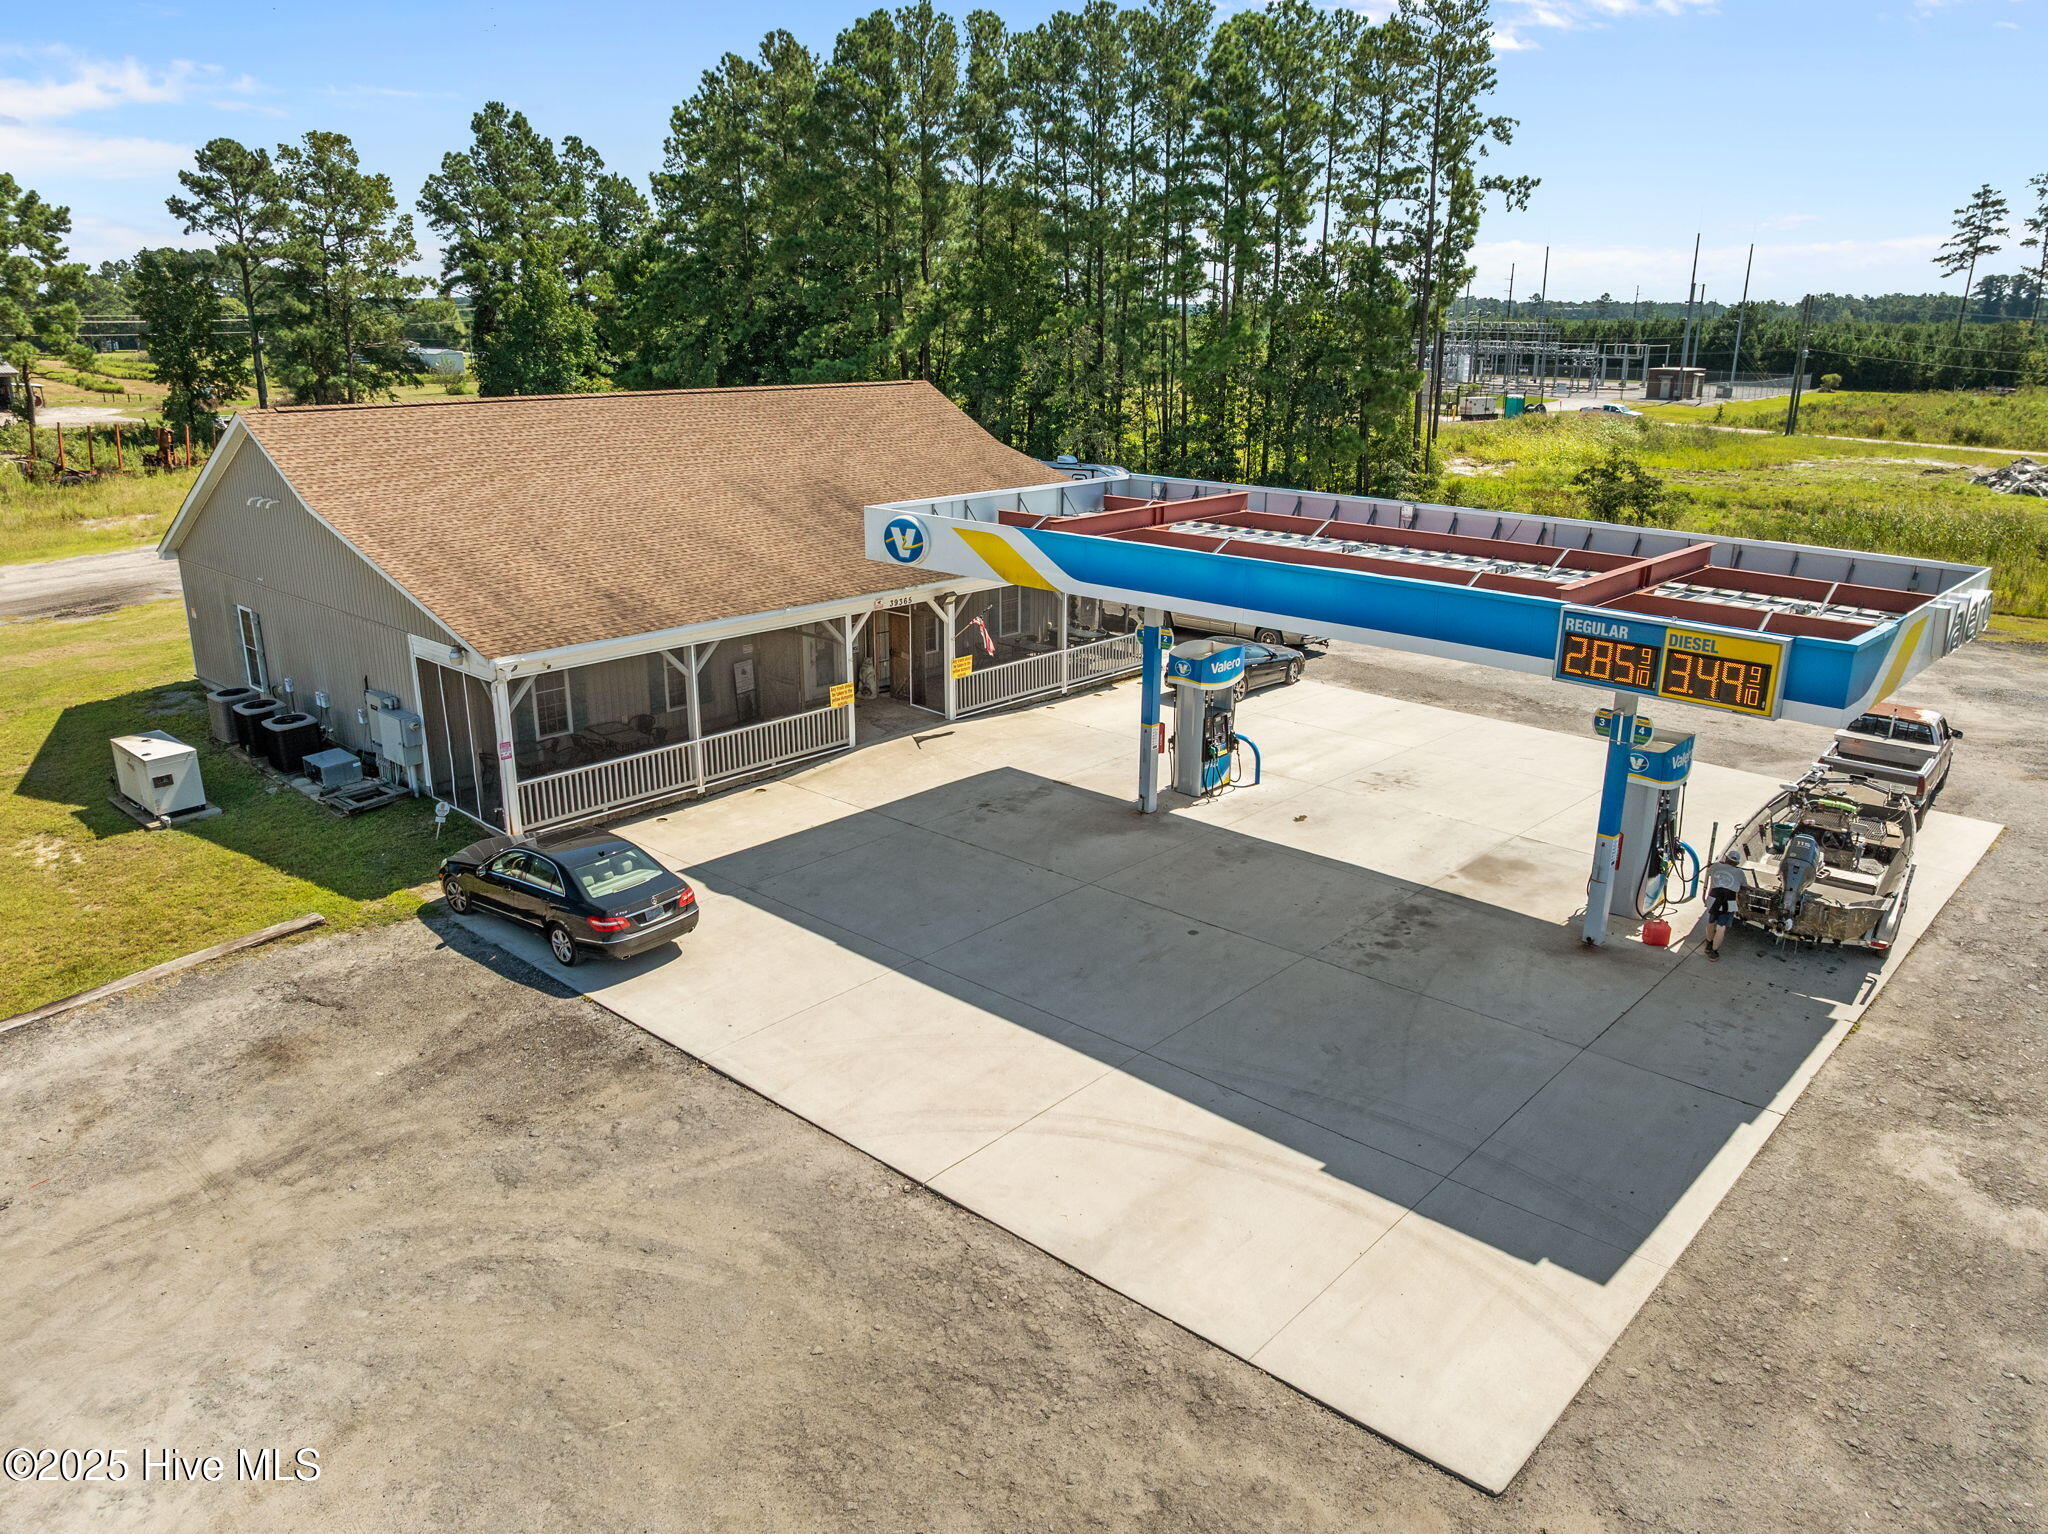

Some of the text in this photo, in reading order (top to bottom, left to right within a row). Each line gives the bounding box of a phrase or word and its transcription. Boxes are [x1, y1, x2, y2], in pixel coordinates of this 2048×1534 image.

[1565, 617, 1629, 640] REGULAR
[1163, 635, 1168, 643] 2
[1668, 633, 1719, 654] DIESEL
[1211, 657, 1241, 674] Valero
[1564, 636, 1635, 684] 2.85
[1668, 653, 1746, 703] 3.49
[1599, 718, 1606, 726] 3
[1638, 726, 1645, 735] 4
